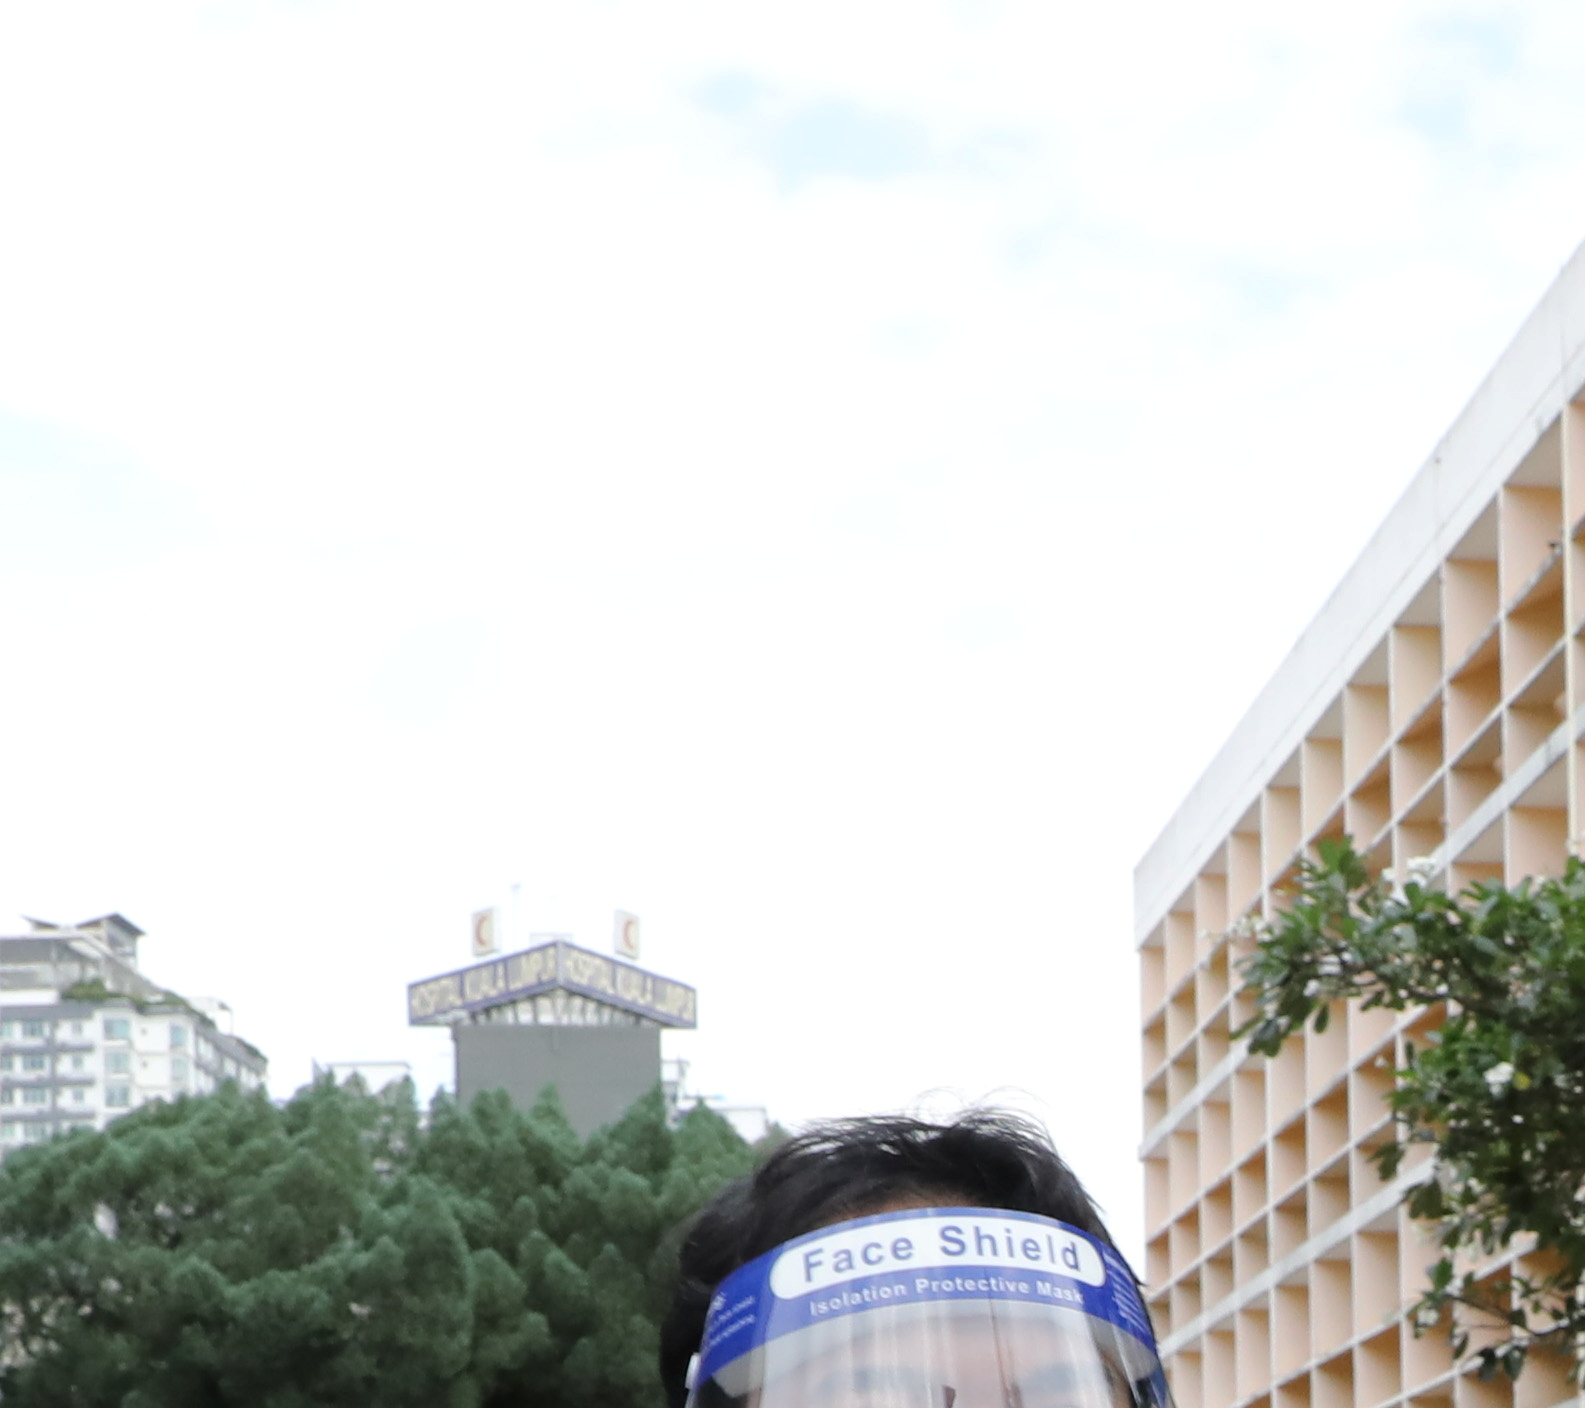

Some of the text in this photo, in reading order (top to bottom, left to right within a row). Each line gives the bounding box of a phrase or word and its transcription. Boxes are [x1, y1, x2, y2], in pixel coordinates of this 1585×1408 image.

[802, 1225, 1081, 1283] Face Shield
[810, 1278, 1084, 1316] Isolation Protective Mask
